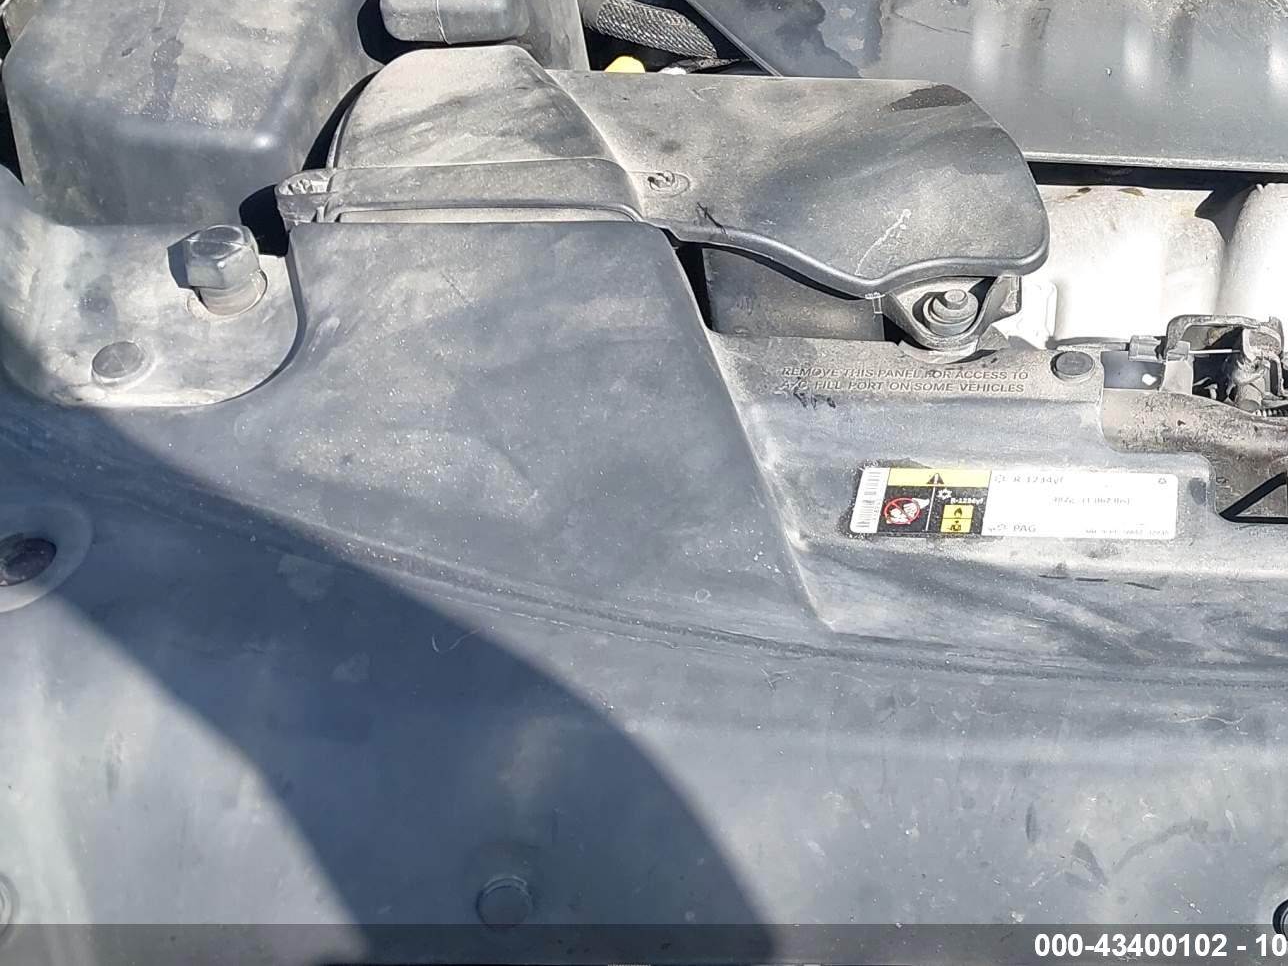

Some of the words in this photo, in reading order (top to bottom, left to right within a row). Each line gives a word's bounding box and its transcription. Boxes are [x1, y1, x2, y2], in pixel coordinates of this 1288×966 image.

[781, 367, 841, 378] REMOVE
[845, 368, 876, 379] THIS
[877, 368, 922, 380] PANEL
[925, 369, 953, 381] FOR
[955, 370, 1009, 381] ACCESS
[1012, 370, 1030, 381] TO
[813, 380, 842, 392] FILL
[847, 381, 885, 392] PORT
[889, 381, 910, 392] ON
[912, 382, 954, 393] SOME
[958, 382, 1026, 394] VEHICLES
